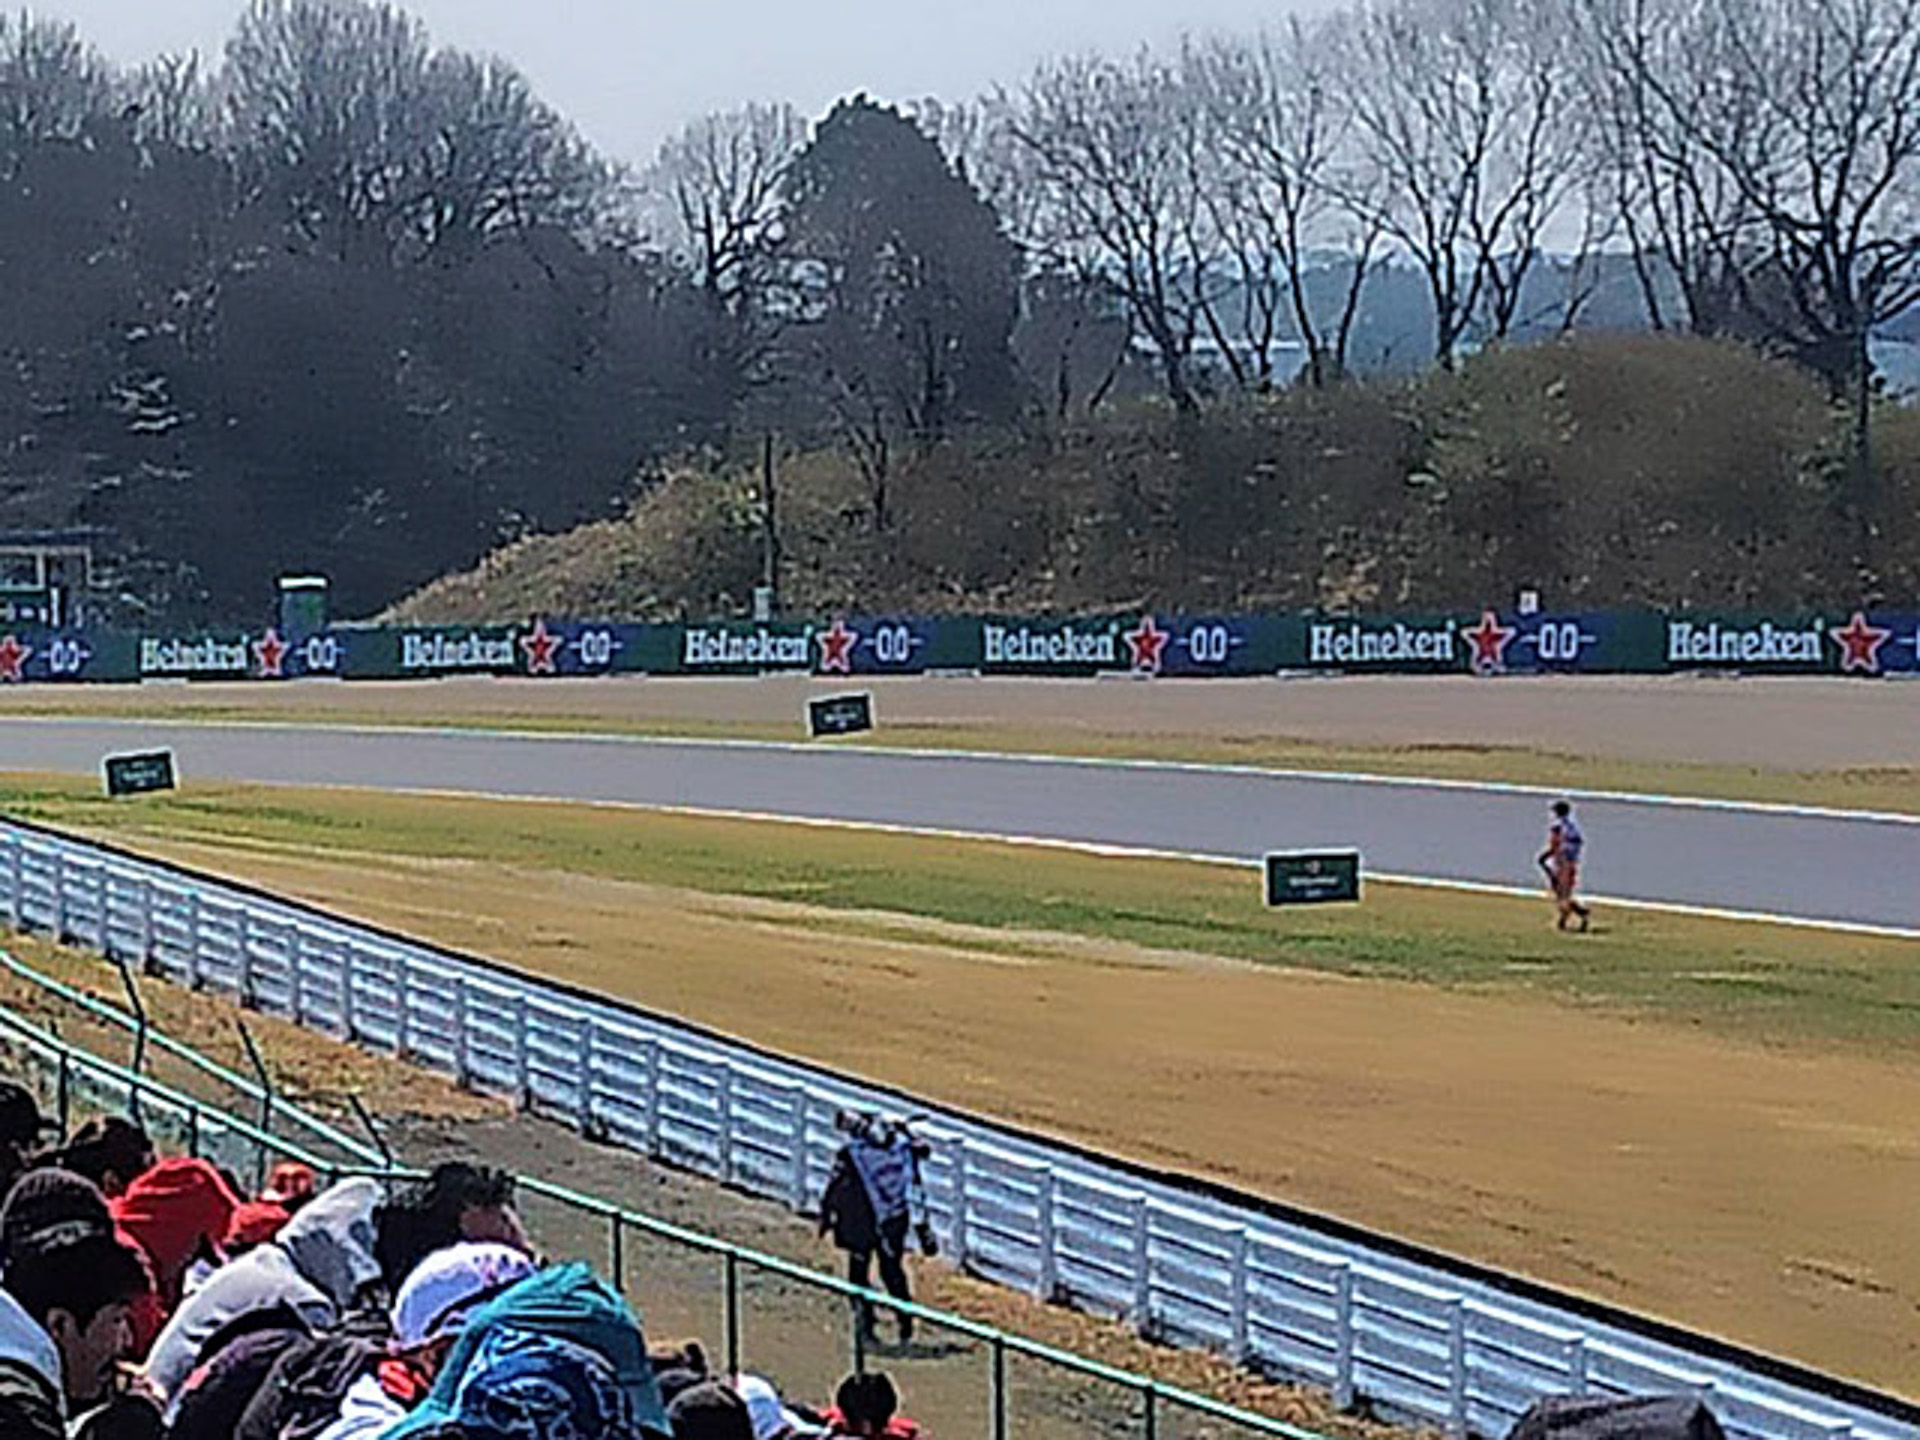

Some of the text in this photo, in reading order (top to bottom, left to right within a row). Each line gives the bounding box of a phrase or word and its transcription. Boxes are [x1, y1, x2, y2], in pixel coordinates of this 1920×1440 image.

[403, 633, 514, 667] Heineken
[685, 628, 809, 663] Heineken
[984, 624, 1115, 662] Heineken
[1310, 623, 1454, 661] Heineken
[1668, 622, 1822, 661] Heineken
